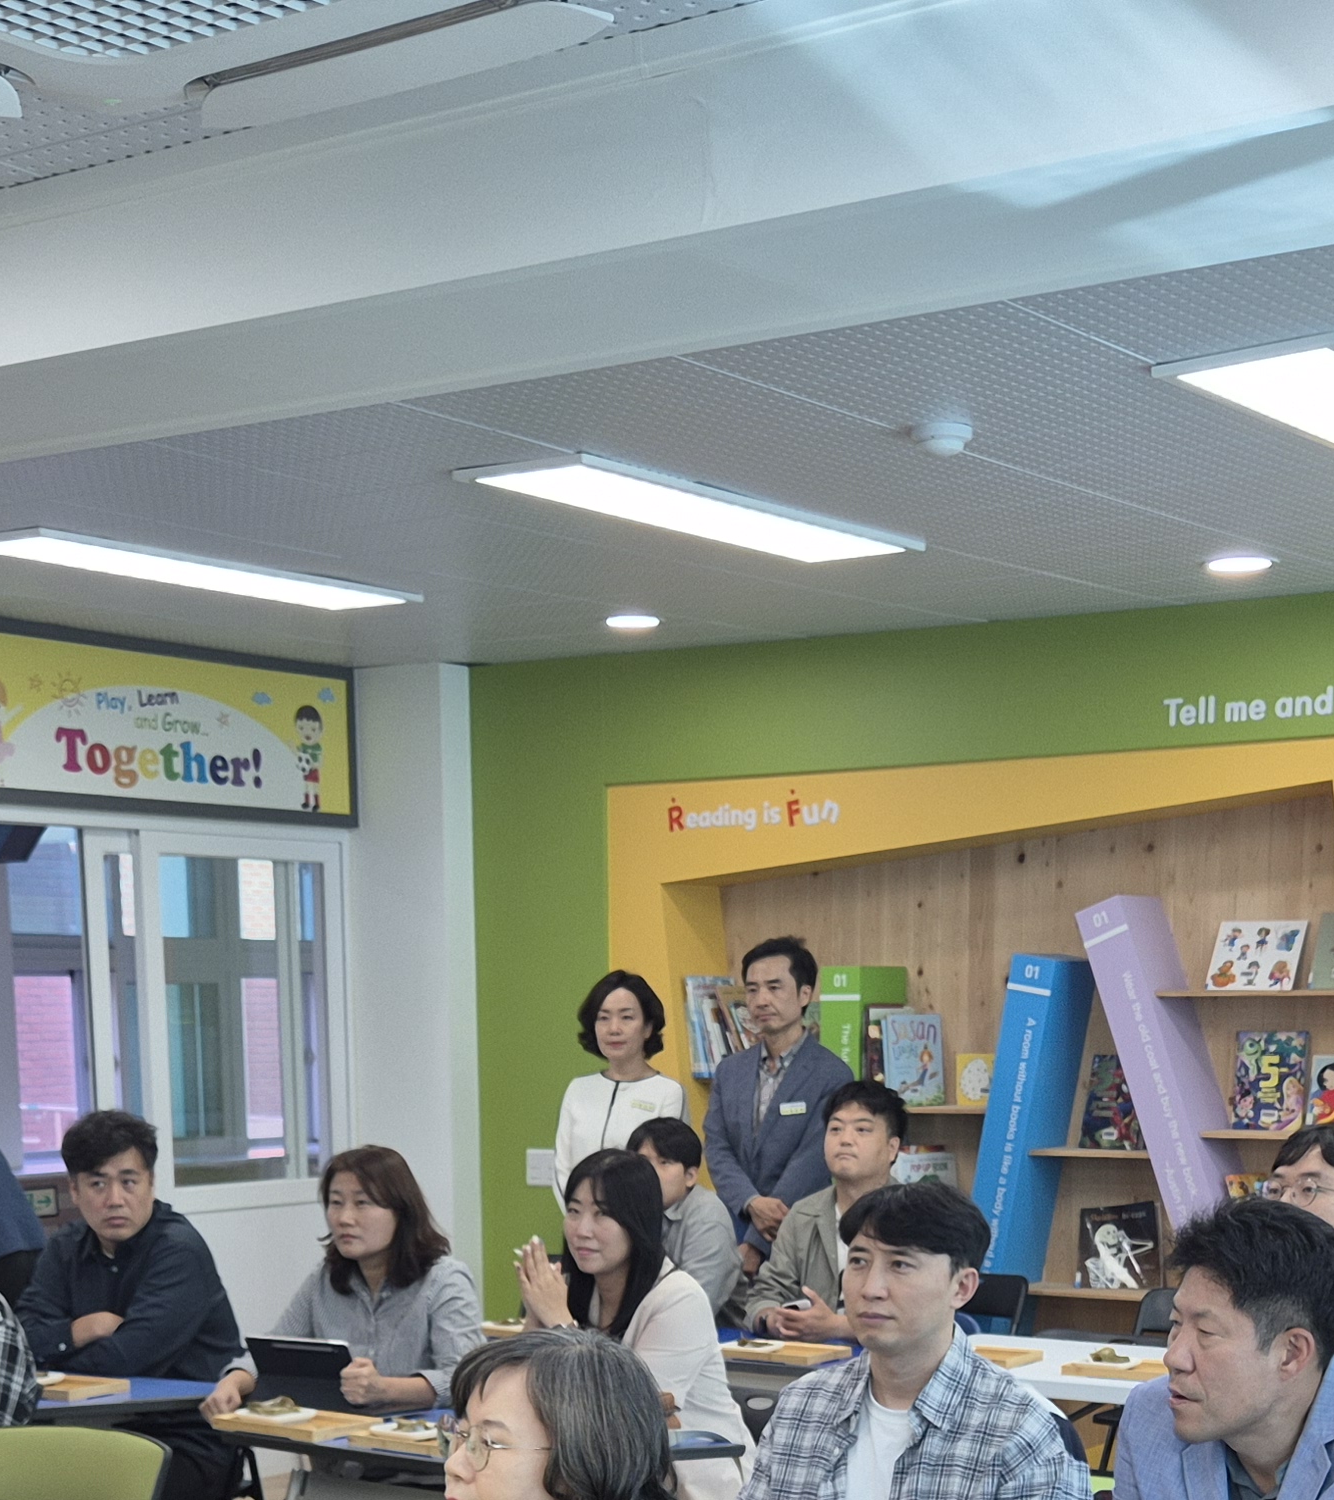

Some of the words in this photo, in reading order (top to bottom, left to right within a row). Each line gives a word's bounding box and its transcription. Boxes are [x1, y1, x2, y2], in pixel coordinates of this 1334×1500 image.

[137, 690, 179, 708] Learn
[1163, 695, 1216, 727] Tell
[1224, 698, 1267, 723] me
[1274, 685, 1334, 719] and
[134, 713, 158, 731] and
[54, 726, 263, 789] Together!
[667, 804, 756, 832] Reading
[763, 801, 782, 824] is
[786, 797, 839, 827] Fun
[1093, 911, 1109, 928] 01
[833, 973, 848, 988] 01
[1025, 964, 1040, 979] 01
[1131, 1001, 1145, 1022] the
[1137, 1022, 1151, 1042] old
[1019, 1029, 1033, 1059] room
[1011, 1061, 1028, 1102] without
[1152, 1070, 1167, 1095] and
[1158, 1095, 1175, 1119] buy
[1005, 1104, 1021, 1140] books
[1003, 1142, 1014, 1153] is
[999, 1154, 1012, 1175] like
[991, 1186, 1006, 1216] body
